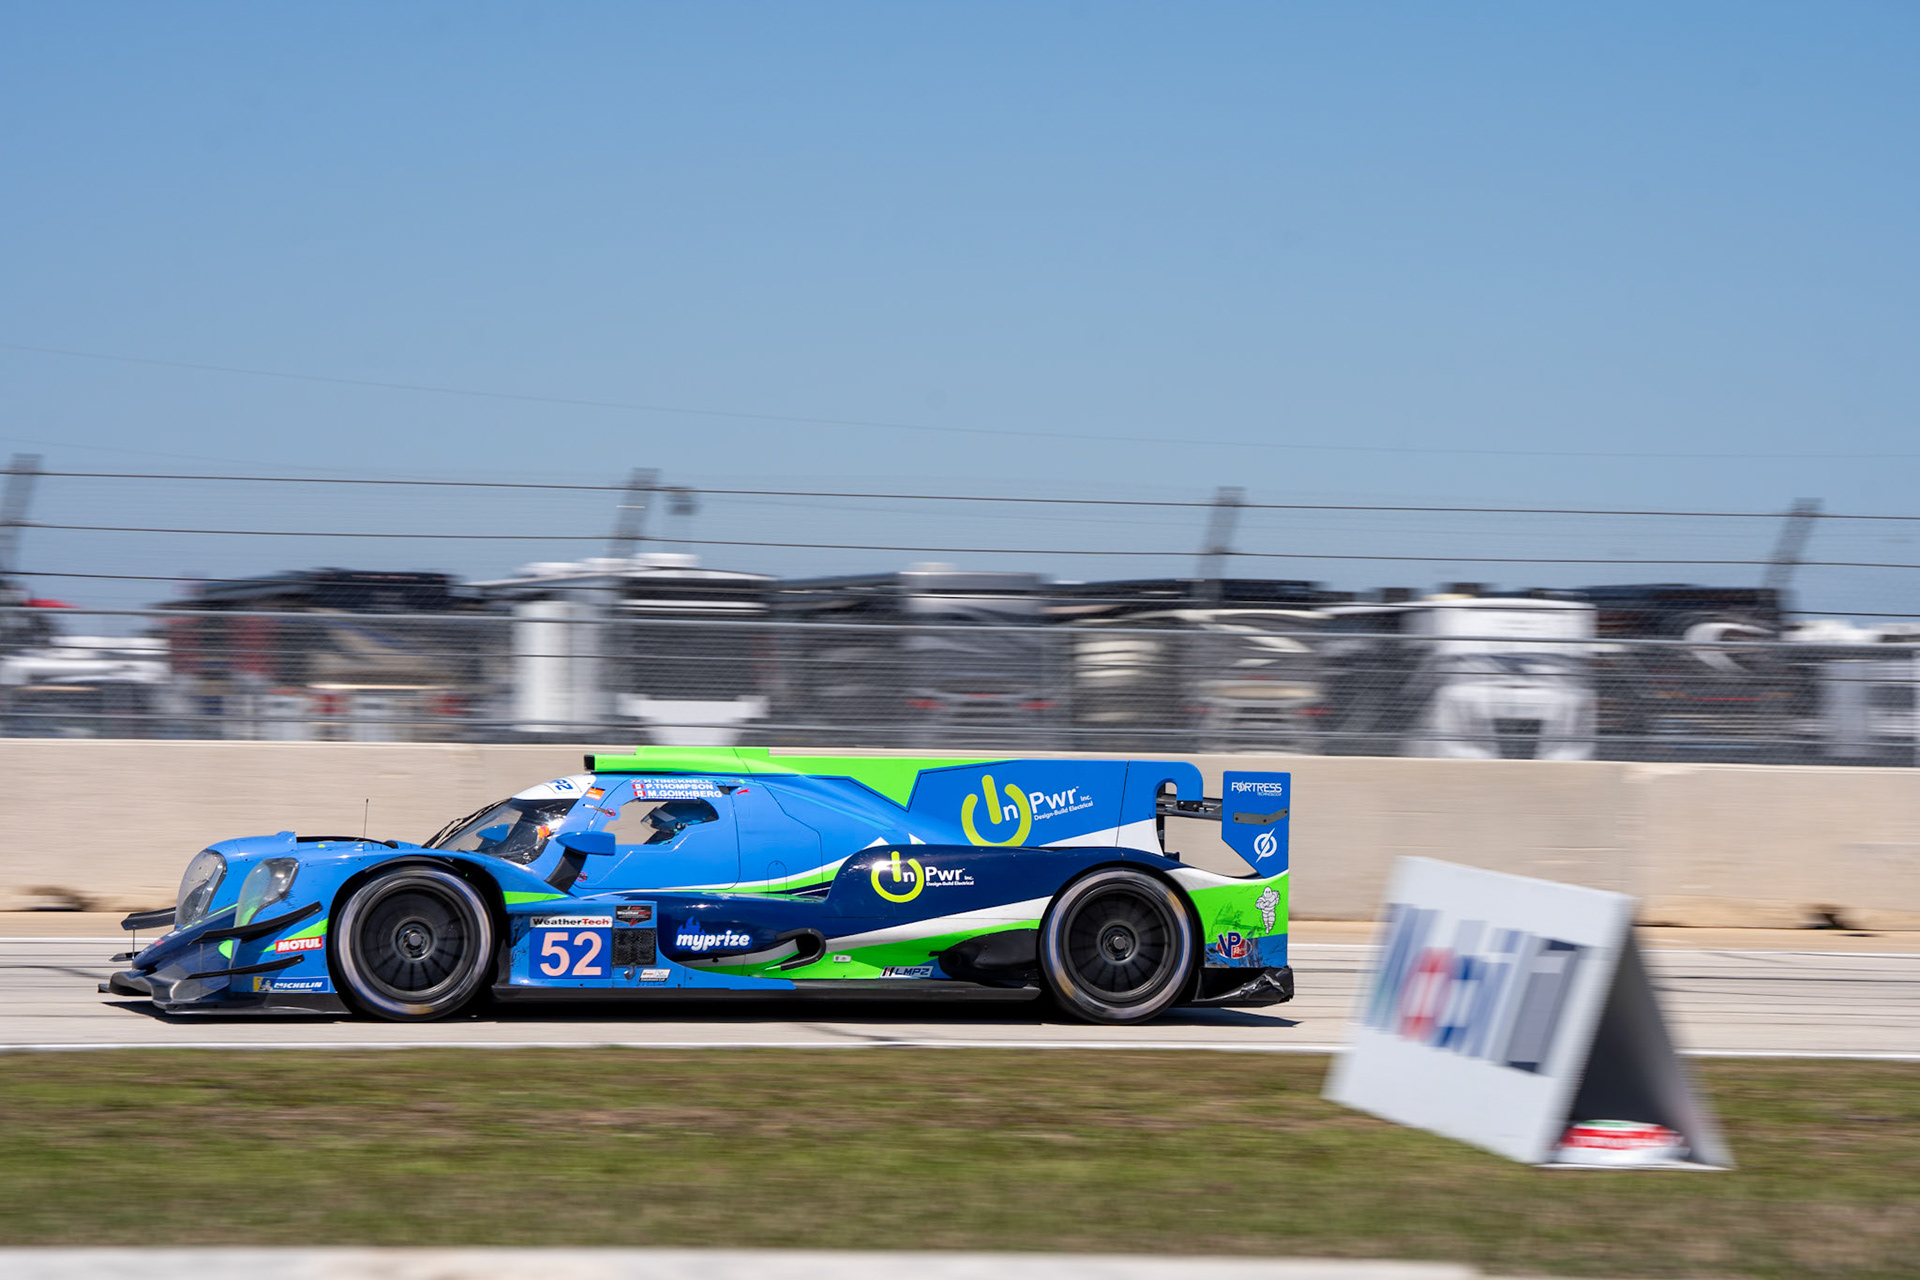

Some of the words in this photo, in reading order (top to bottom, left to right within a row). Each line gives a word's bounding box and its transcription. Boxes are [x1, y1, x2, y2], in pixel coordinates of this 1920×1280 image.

[532, 918, 609, 926] WeatherTech
[277, 938, 321, 951] MOTUL
[676, 929, 750, 951] myprize
[1217, 931, 1242, 958] VP
[540, 931, 602, 976] 52
[894, 967, 931, 976] LMP2
